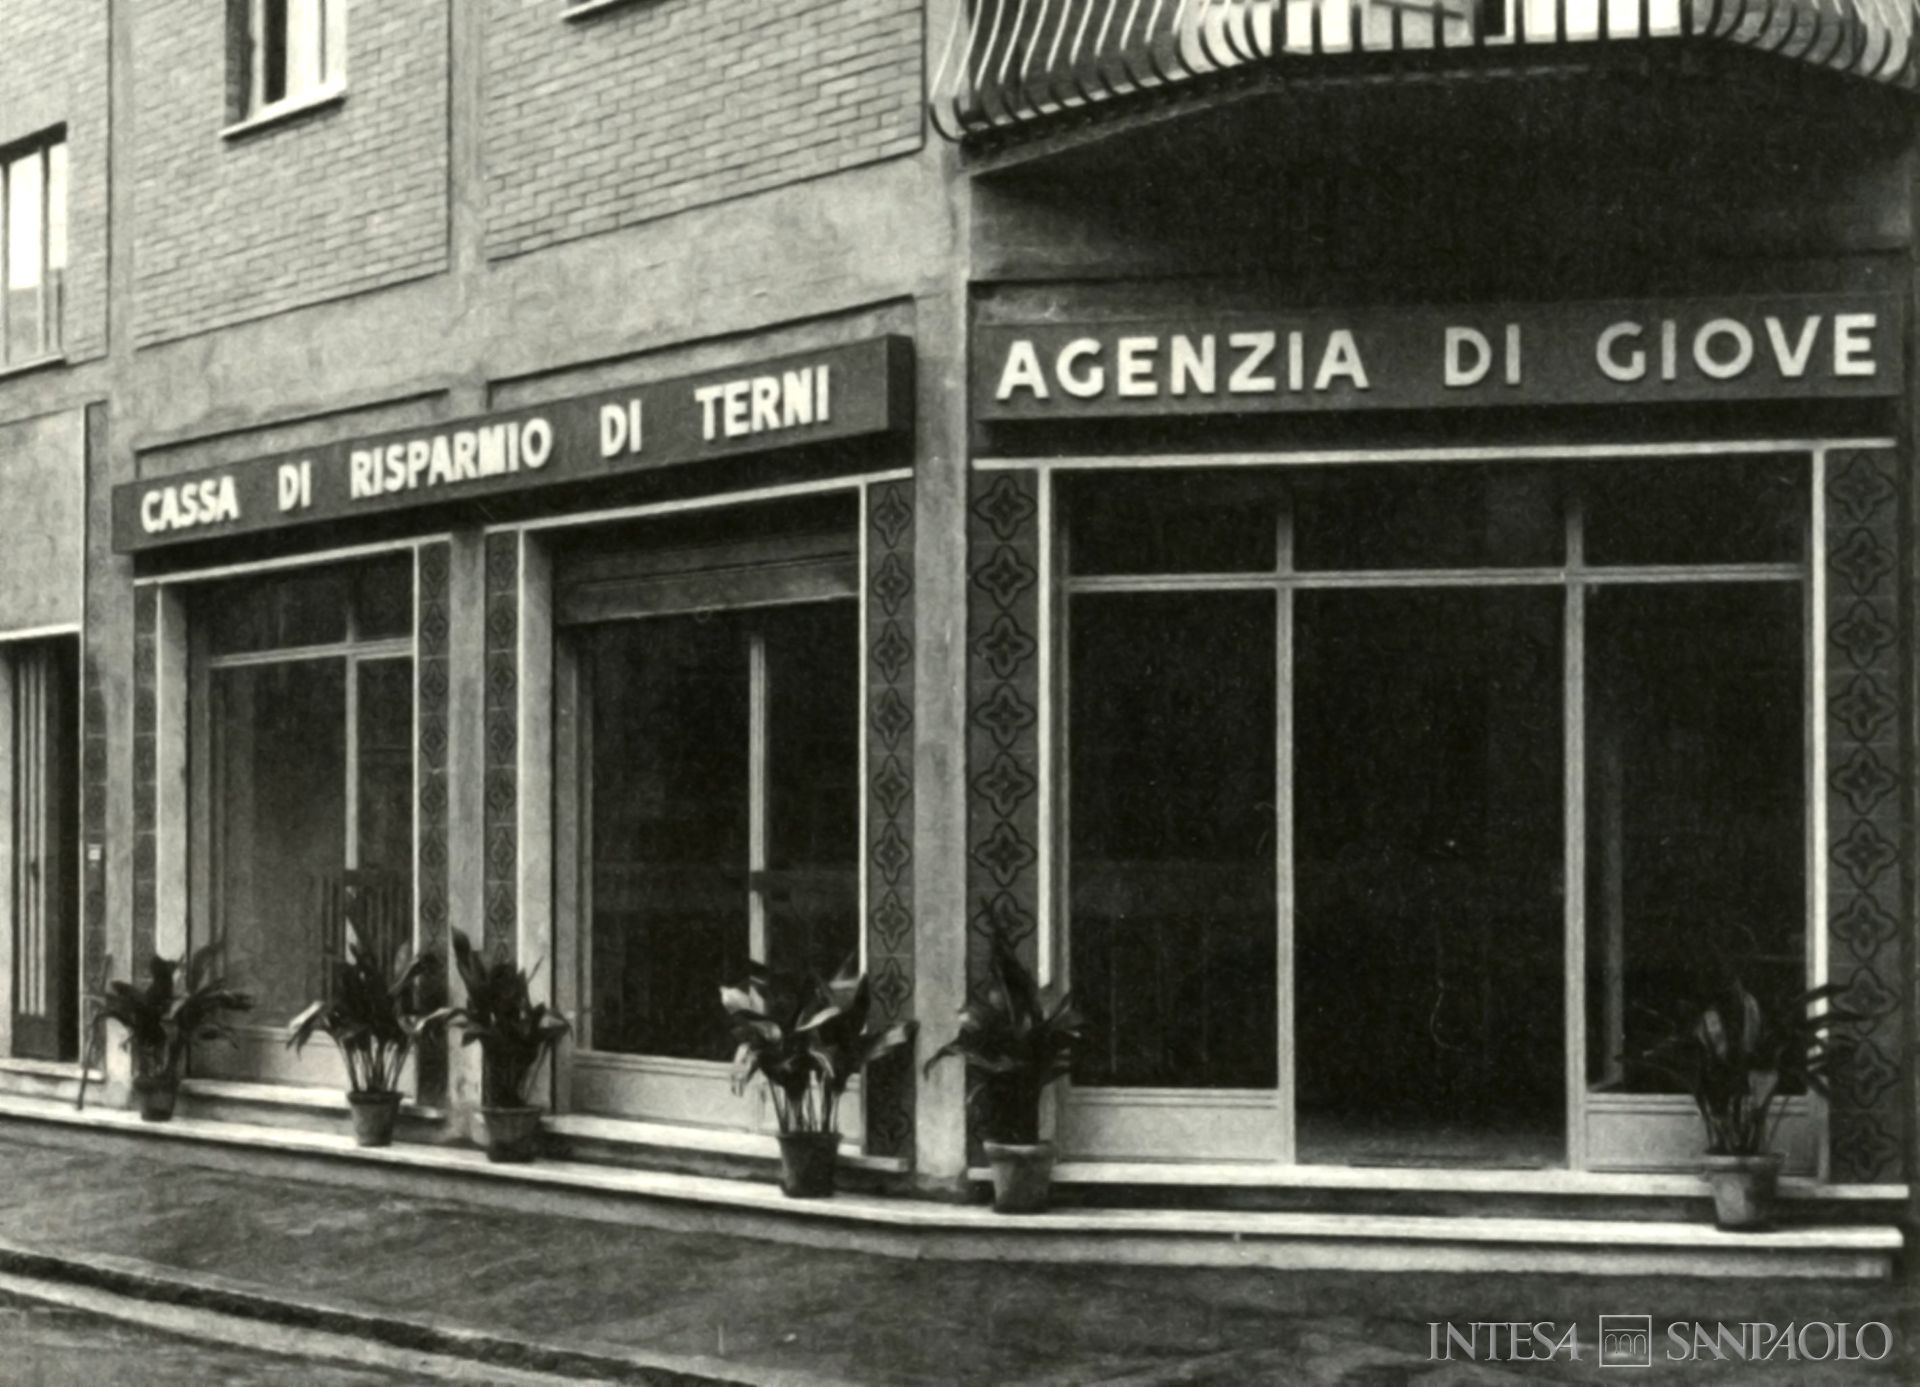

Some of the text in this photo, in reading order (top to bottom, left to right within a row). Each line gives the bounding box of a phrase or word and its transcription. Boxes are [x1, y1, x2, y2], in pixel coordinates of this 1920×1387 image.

[994, 312, 1877, 400] AGENZIA DI GIOVE
[140, 364, 831, 534] CASSA DI RISPARMIO DI TERNI
